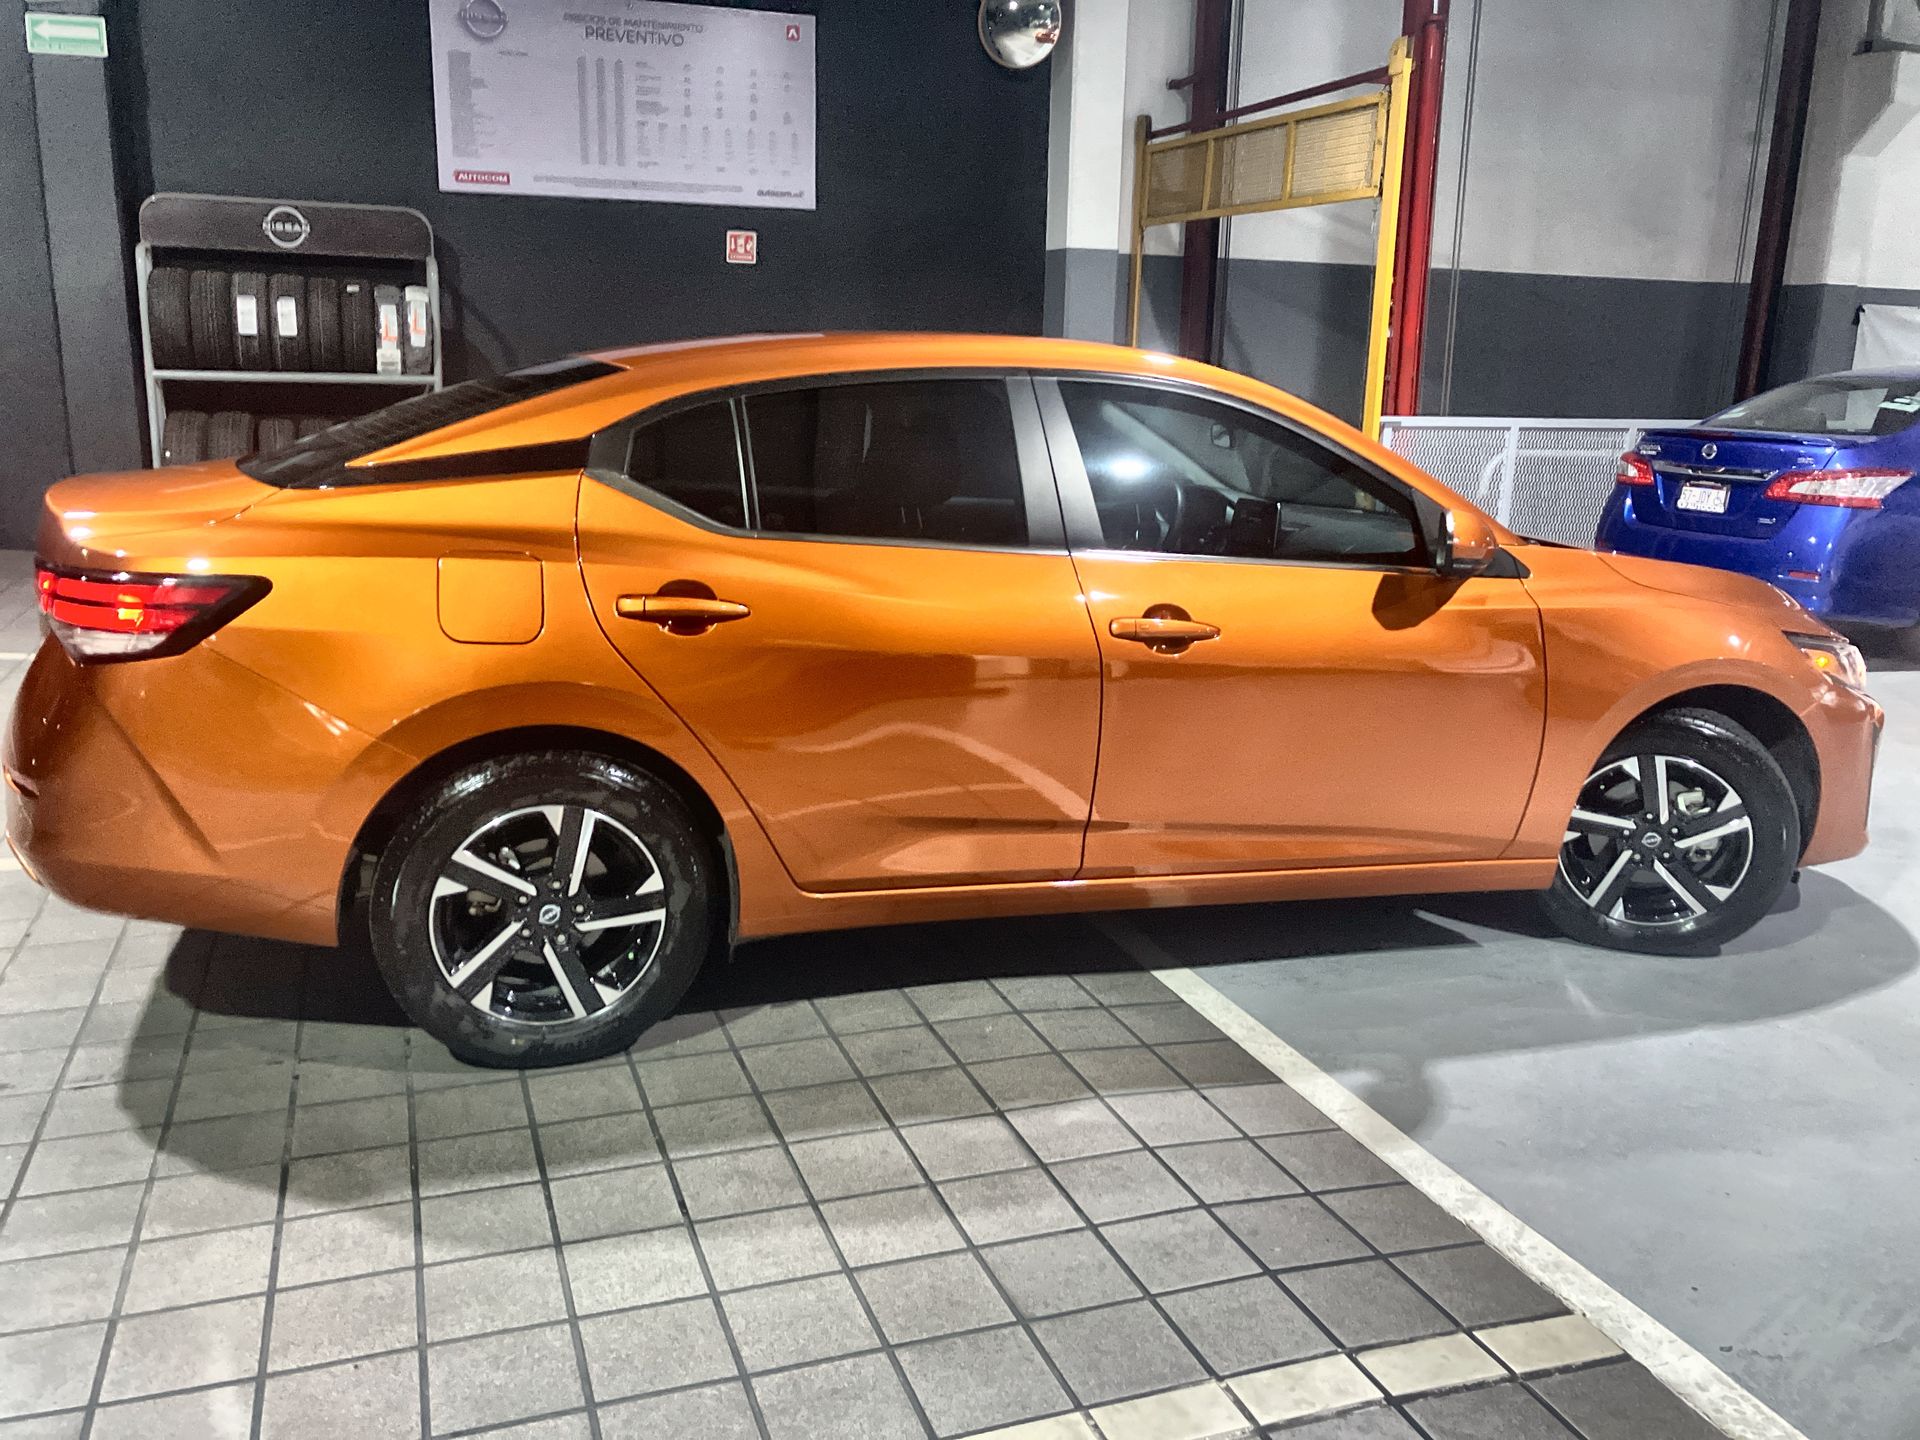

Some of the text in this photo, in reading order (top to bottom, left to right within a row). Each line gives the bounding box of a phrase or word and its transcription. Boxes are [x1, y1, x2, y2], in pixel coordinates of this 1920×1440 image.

[608, 17, 622, 26] DE
[585, 25, 685, 47] PREVENTIVO
[458, 173, 508, 183] AUTOCOM
